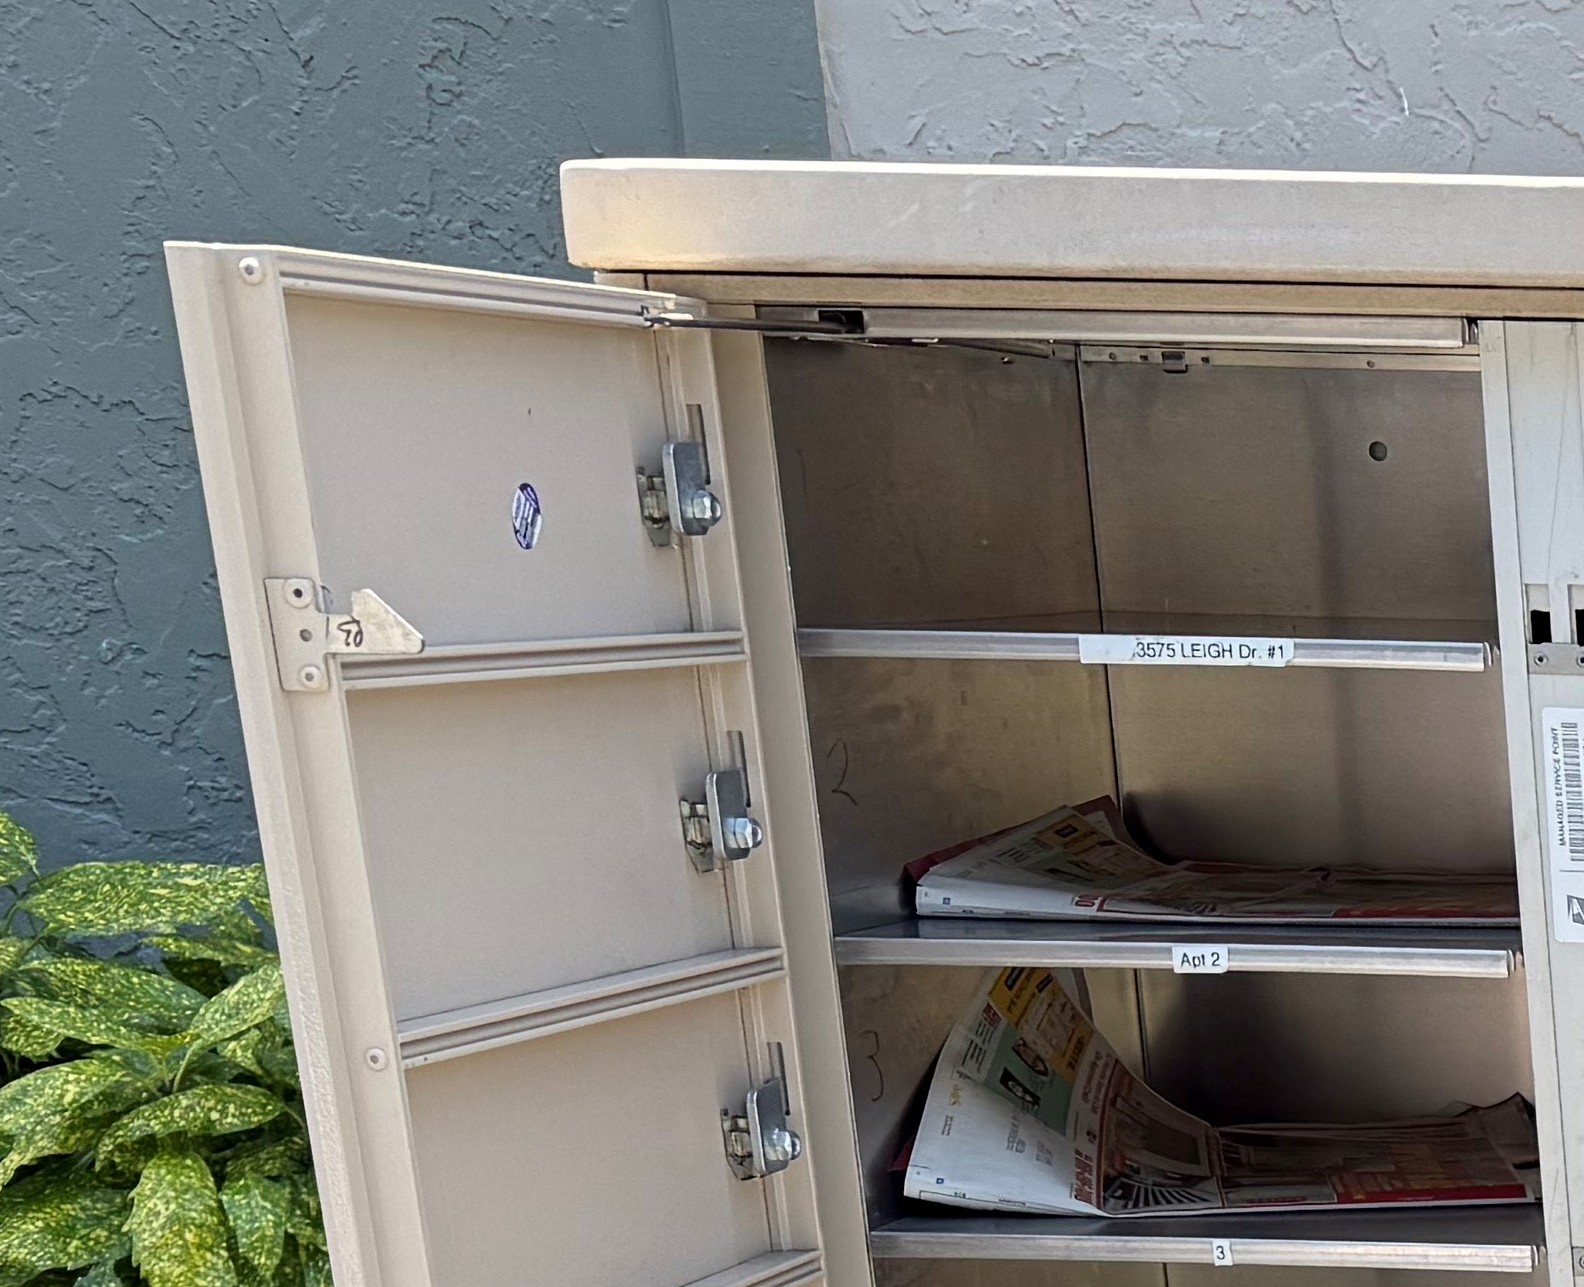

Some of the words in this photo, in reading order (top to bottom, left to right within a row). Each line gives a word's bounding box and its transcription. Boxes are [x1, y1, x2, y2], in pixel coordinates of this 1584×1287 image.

[1136, 641, 1176, 658] 3575
[1181, 643, 1233, 659] LEIGH
[1239, 644, 1263, 660] Dr.
[1267, 643, 1285, 659] #1
[1550, 727, 1560, 756] POINT
[1554, 758, 1564, 798] SERVICE
[1557, 801, 1568, 847] MANAGED
[1180, 952, 1206, 969] Apt
[1210, 951, 1220, 967] 2
[1215, 1244, 1226, 1261] 3
